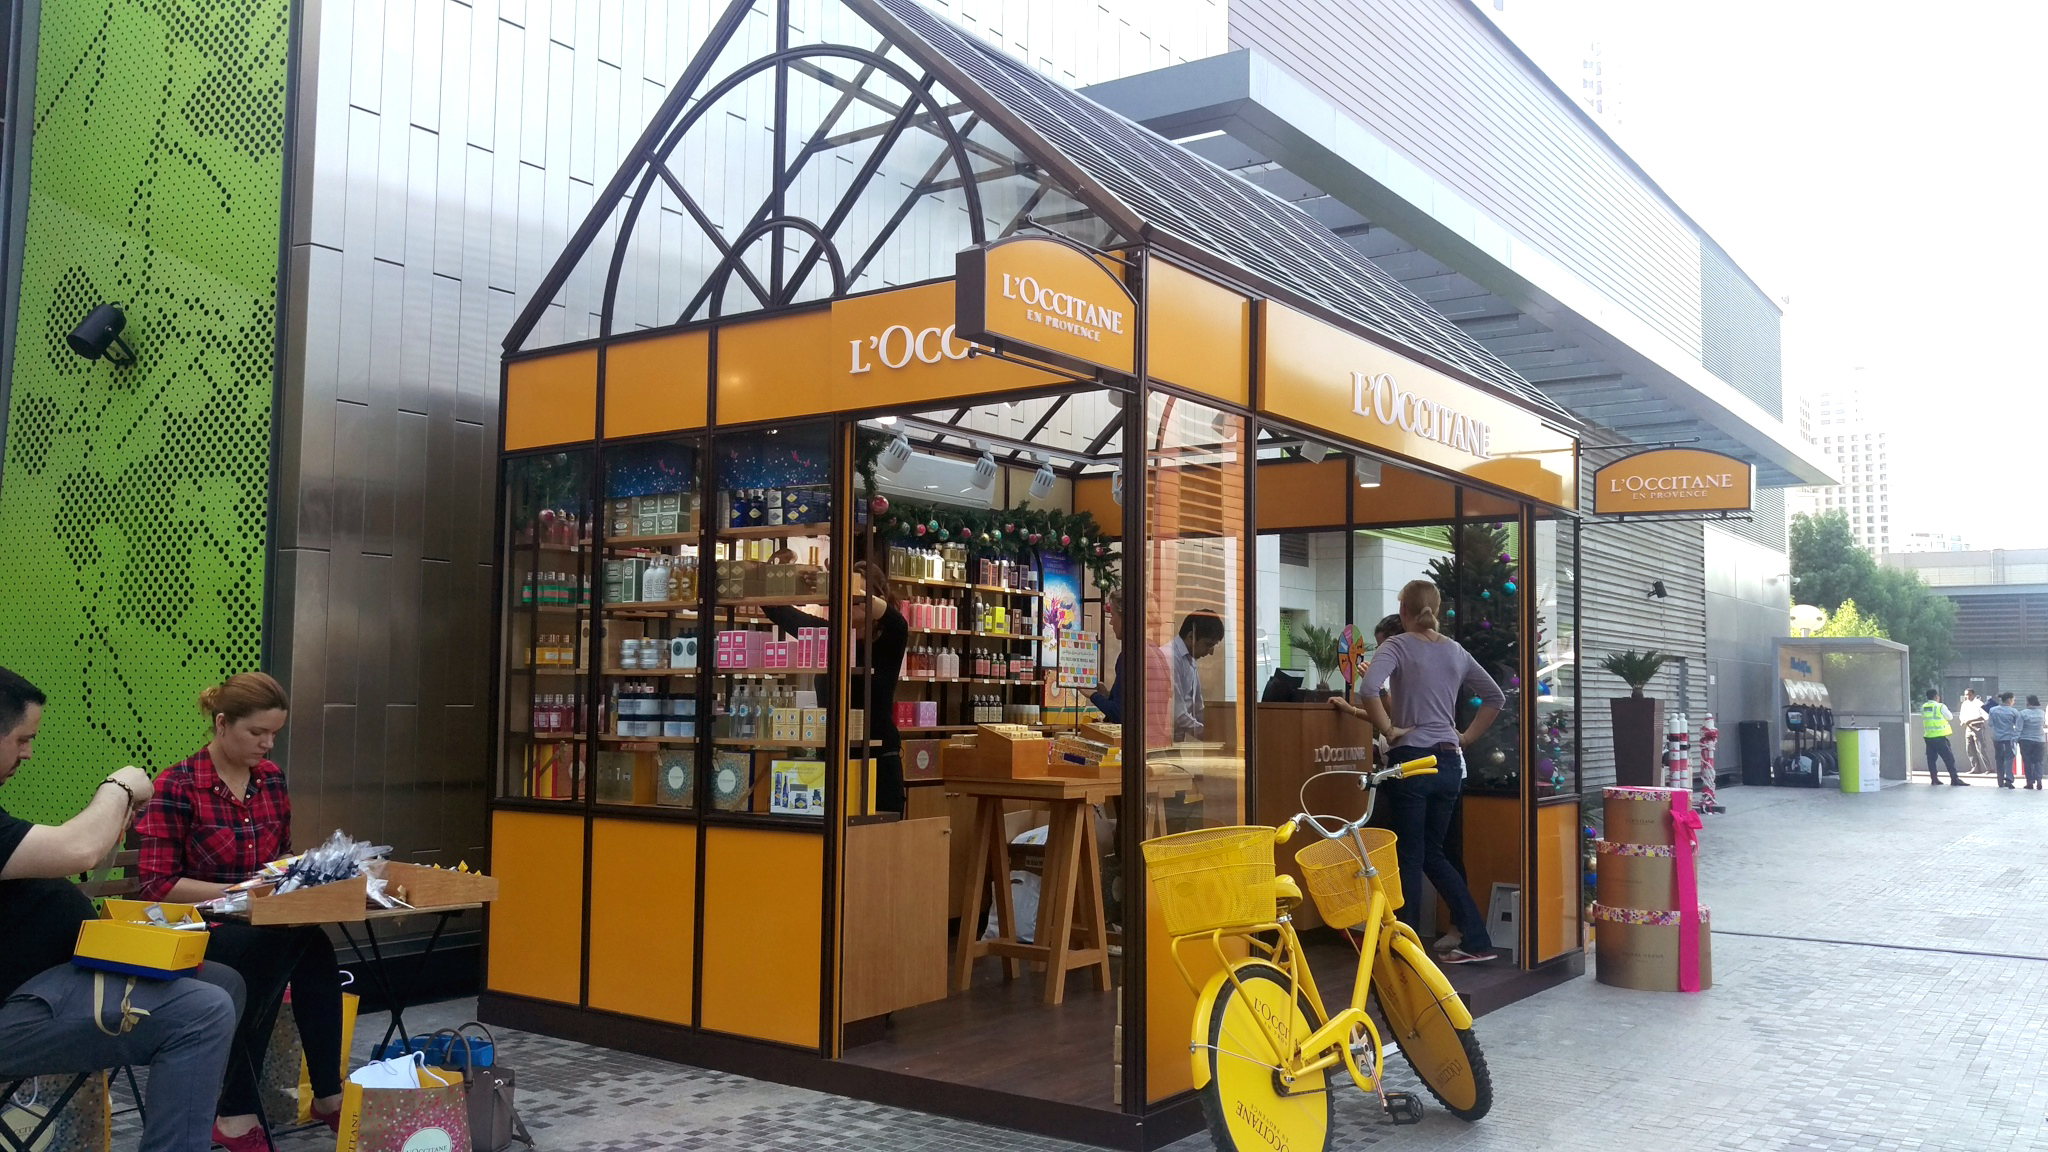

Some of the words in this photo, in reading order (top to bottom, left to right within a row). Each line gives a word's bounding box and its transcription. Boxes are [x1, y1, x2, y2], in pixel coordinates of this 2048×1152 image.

[1002, 273, 1124, 334] L'OCCITANE
[1027, 309, 1042, 322] EN
[1045, 315, 1101, 341] PROVENCE
[849, 324, 970, 374] L'OCC
[1350, 371, 1490, 459] L'OCCITANE
[1611, 474, 1733, 492] L'OCCITANE
[1650, 490, 1707, 499] PROVENCE
[1314, 745, 1366, 763] L'OCCITANE
[1254, 997, 1290, 1040] L'OCCI
[348, 1111, 359, 1152] ITANE
